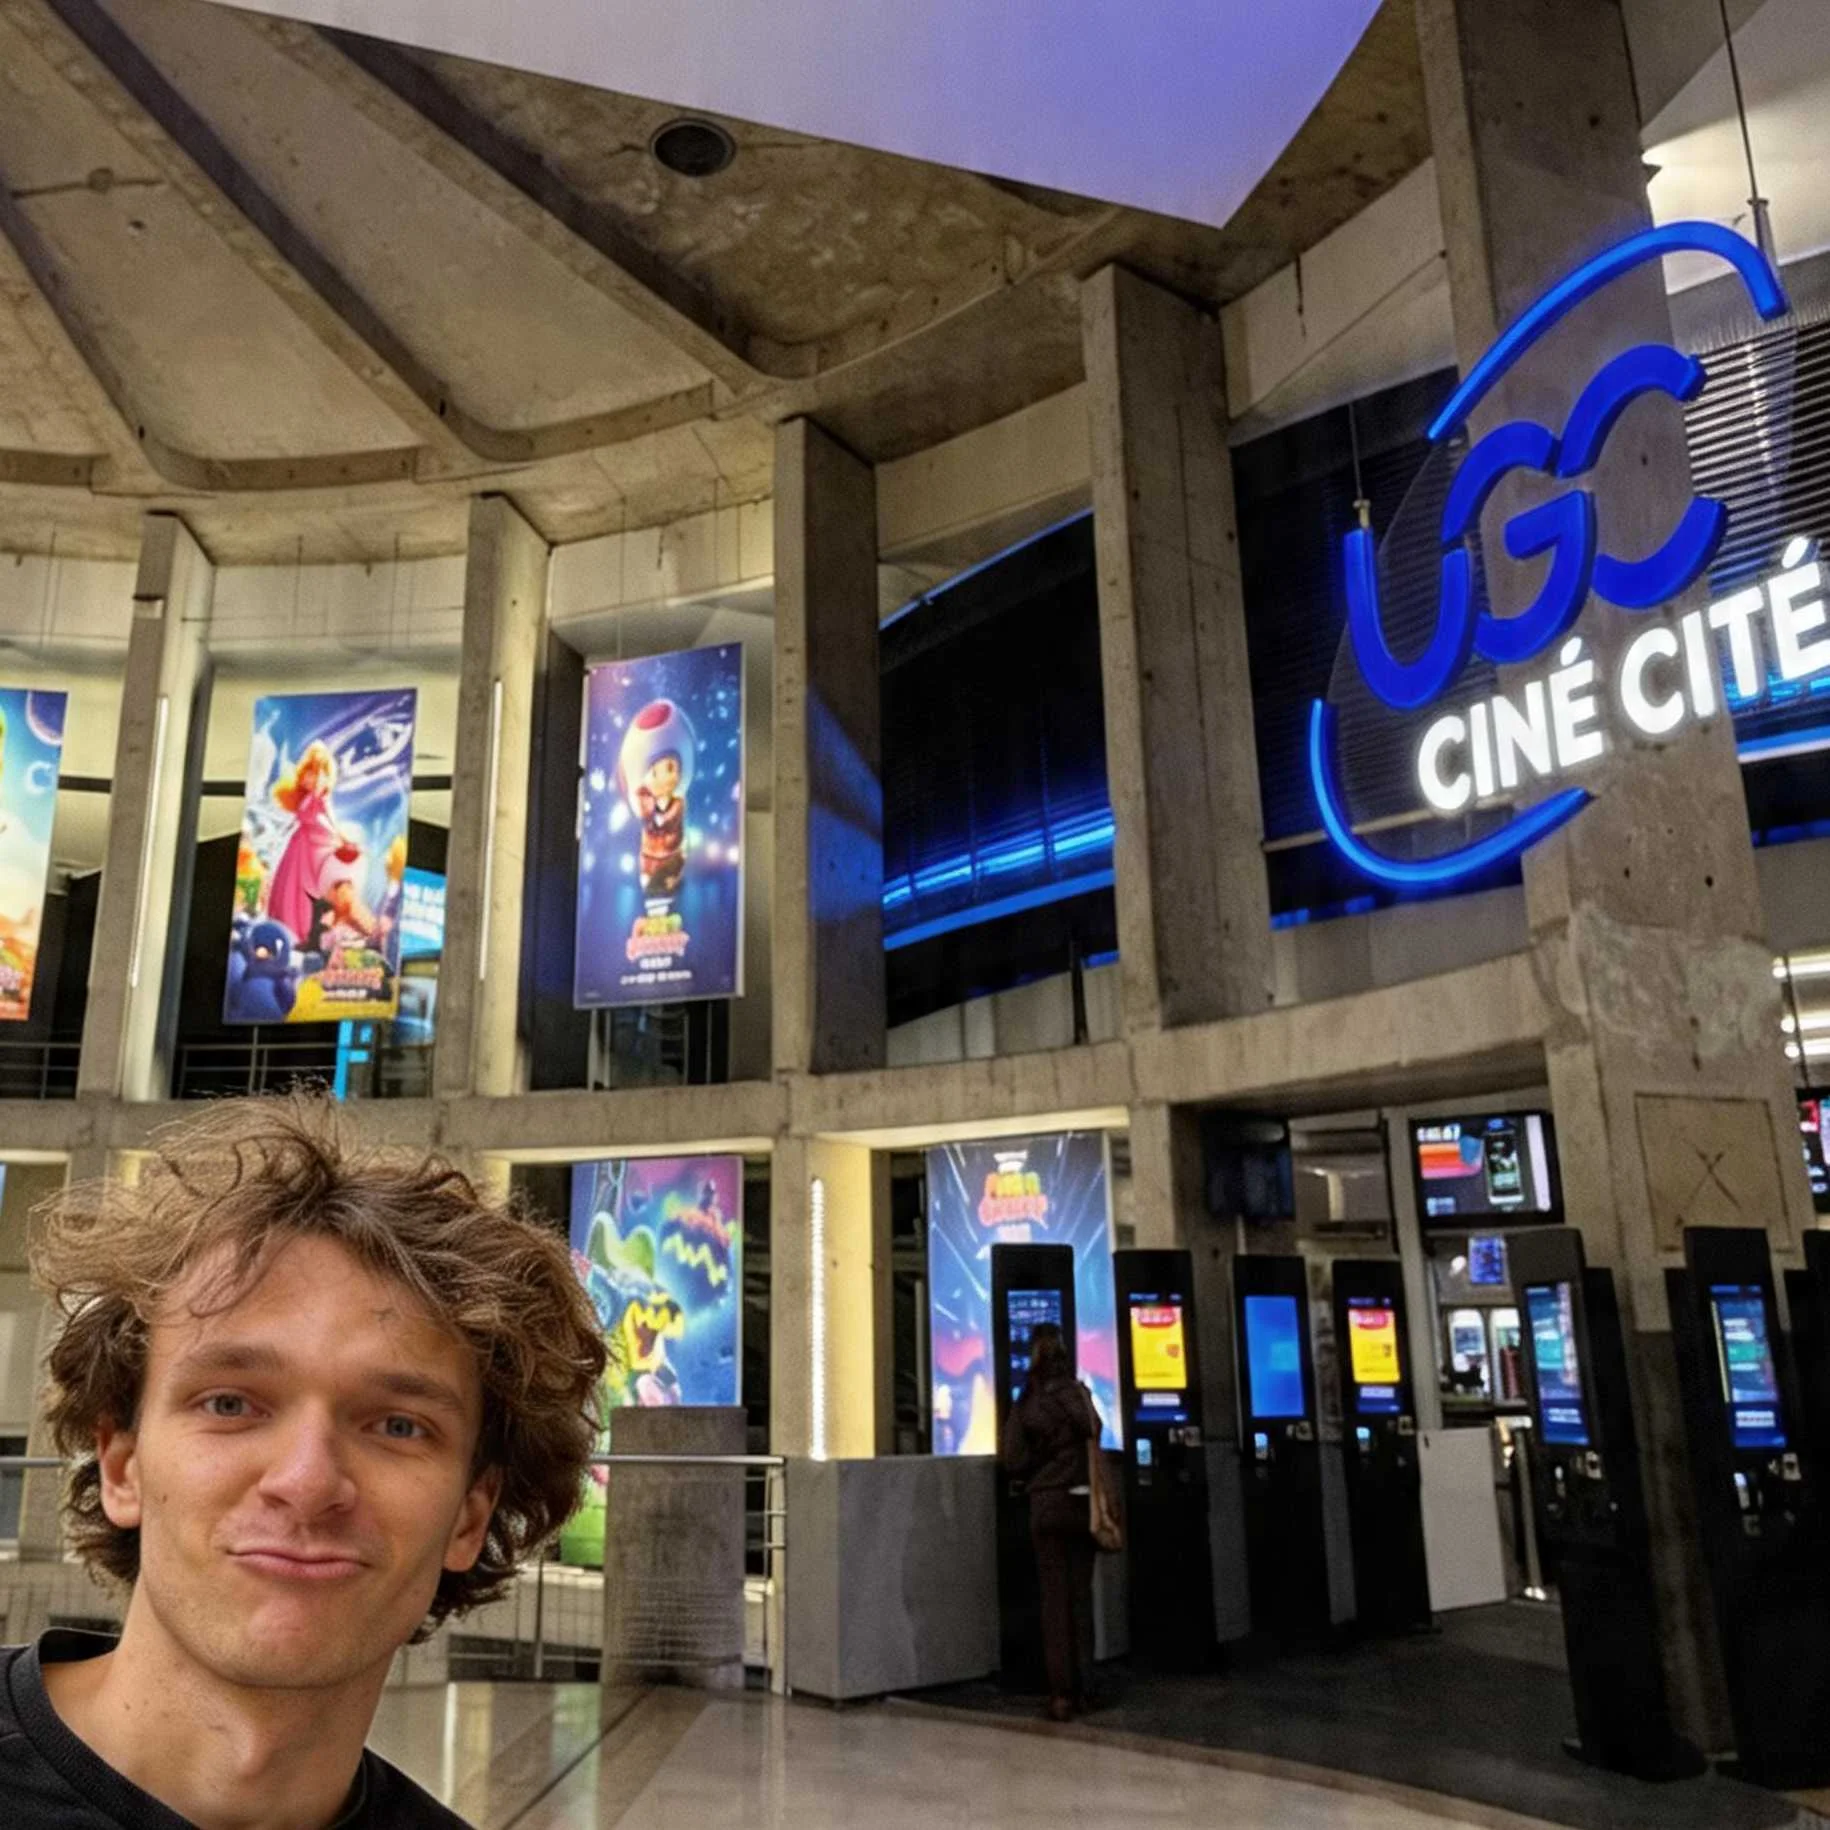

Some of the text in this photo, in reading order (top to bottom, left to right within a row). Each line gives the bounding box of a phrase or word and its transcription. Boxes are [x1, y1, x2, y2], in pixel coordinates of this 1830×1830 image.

[1344, 344, 1727, 709] UGC
[1417, 535, 1830, 811] CINÉ CITÉ
